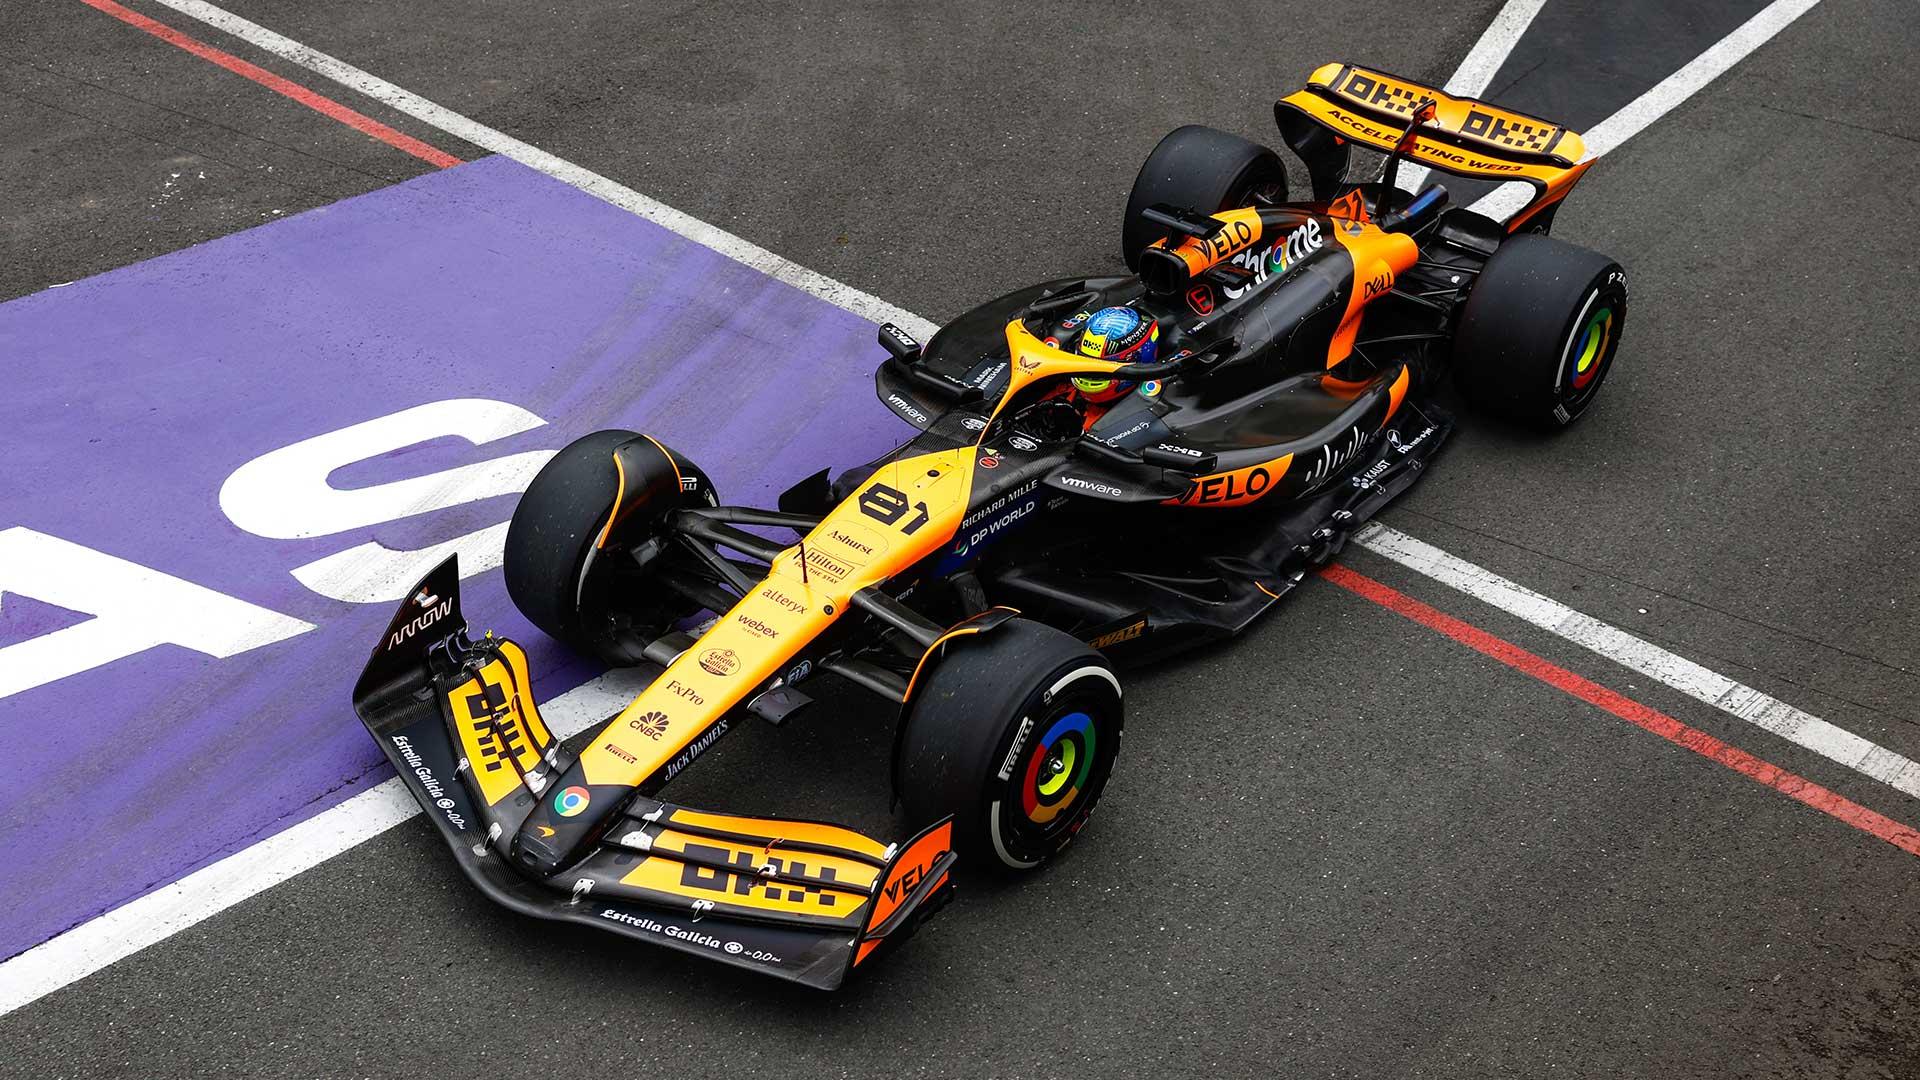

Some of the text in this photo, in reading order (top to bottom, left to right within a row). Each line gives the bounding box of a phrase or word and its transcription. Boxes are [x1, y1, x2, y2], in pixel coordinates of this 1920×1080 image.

[1328, 110, 1524, 172] ACCELEATING WEB3
[1461, 110, 1549, 149] OKX
[1193, 221, 1251, 265] VELO
[1364, 272, 1393, 299] DELL
[1082, 338, 1102, 352] OKX
[888, 394, 927, 423] vmware
[1364, 459, 1391, 479] KAUST
[1060, 476, 1122, 497] vmware
[1176, 467, 1271, 505] VELO
[858, 482, 930, 535] 81
[962, 479, 1038, 530] RICHARD MILLE
[970, 529, 989, 546] DP
[989, 500, 1035, 533] WORLD
[828, 530, 874, 555] Ashurst
[806, 551, 846, 576] Hilton
[809, 568, 823, 576] THE
[823, 574, 840, 584] STAY
[762, 587, 808, 615] alteryx
[738, 614, 779, 639] webex
[709, 651, 735, 667] Estrella
[665, 680, 705, 706] FxPro
[629, 719, 663, 742] CNBC
[605, 743, 638, 765] PIRELLI
[665, 719, 729, 781] JACK DANIEL'S
[998, 716, 1035, 781] PIRELLI
[392, 735, 422, 768] Estrella
[415, 767, 444, 798] Galicia
[600, 909, 662, 933] Estrella
[664, 925, 721, 949] Galicia
